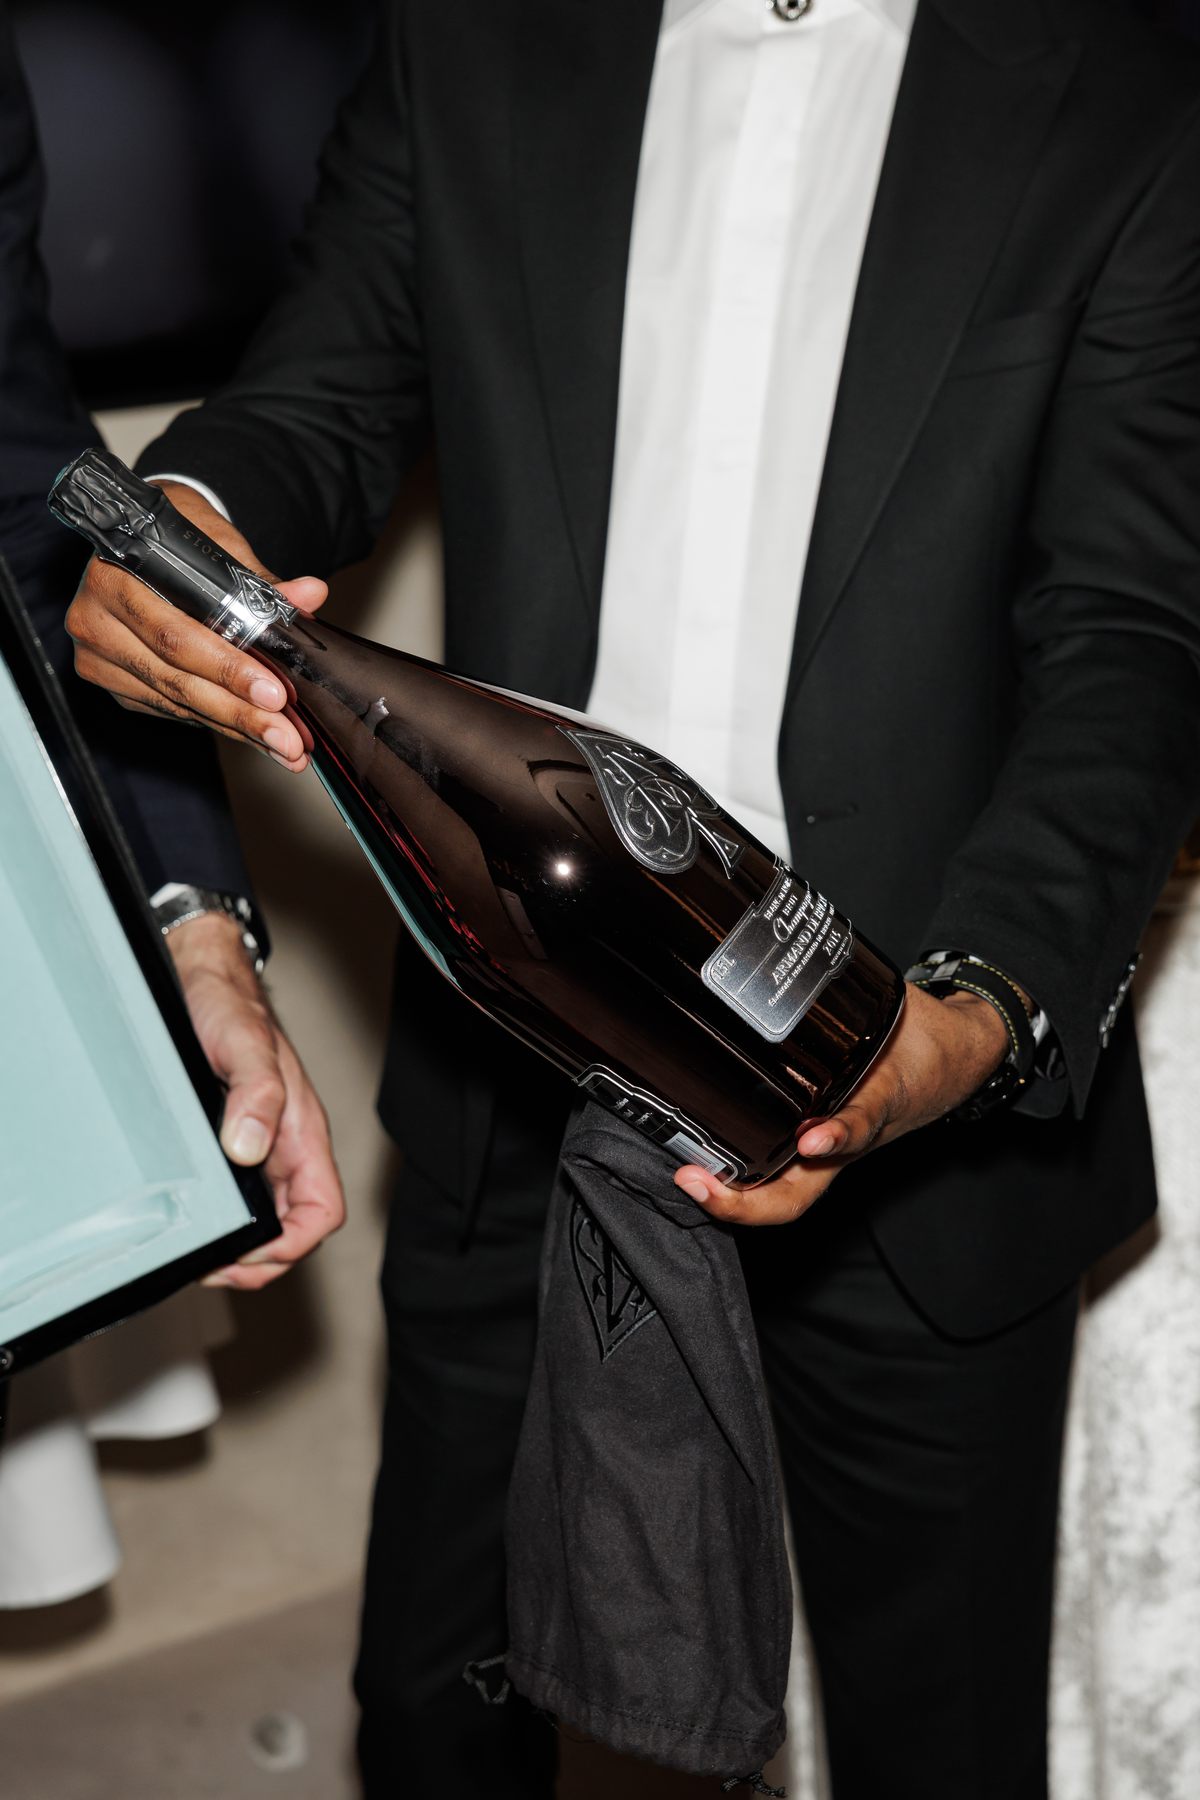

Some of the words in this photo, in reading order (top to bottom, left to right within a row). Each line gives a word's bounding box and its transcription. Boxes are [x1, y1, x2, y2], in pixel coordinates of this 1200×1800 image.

[183, 530, 222, 561] 2015
[782, 893, 798, 916] BRUT
[772, 930, 811, 985] ARMAND
[805, 914, 820, 933] DE
[822, 928, 841, 956] 2015
